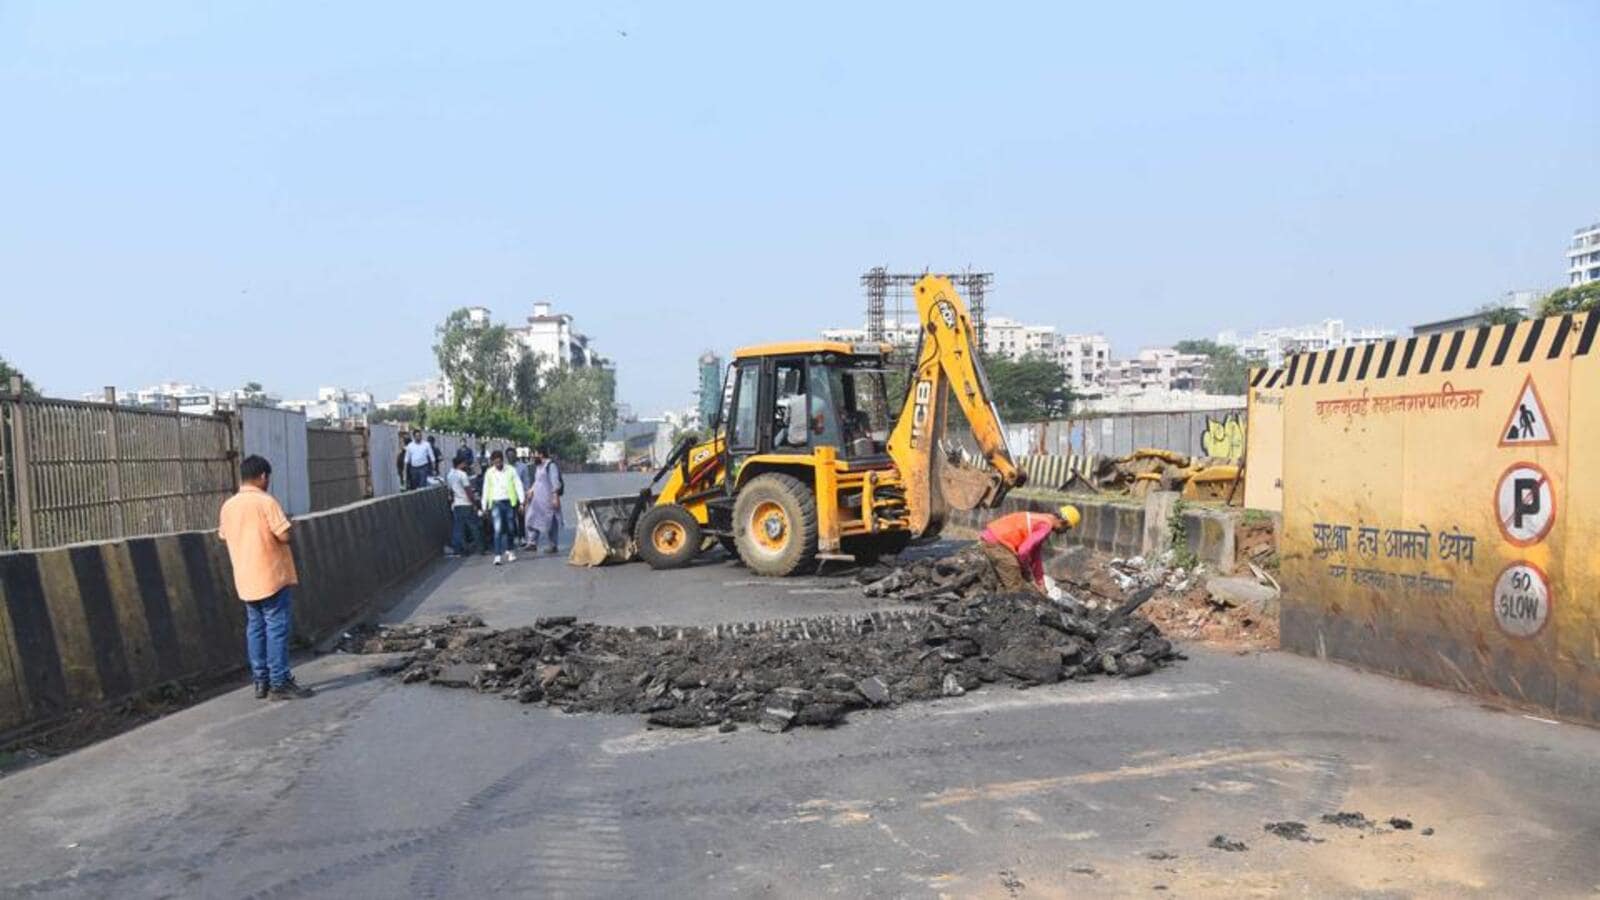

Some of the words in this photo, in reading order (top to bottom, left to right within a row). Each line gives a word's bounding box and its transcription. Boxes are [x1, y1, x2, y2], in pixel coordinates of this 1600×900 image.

[1513, 478, 1541, 528] P
[1313, 524, 1352, 559] सुरक्षा
[1384, 524, 1430, 560] आमचे
[1439, 525, 1475, 565] ध्येय
[1511, 571, 1531, 591] GO
[1500, 594, 1539, 620] SLOW
